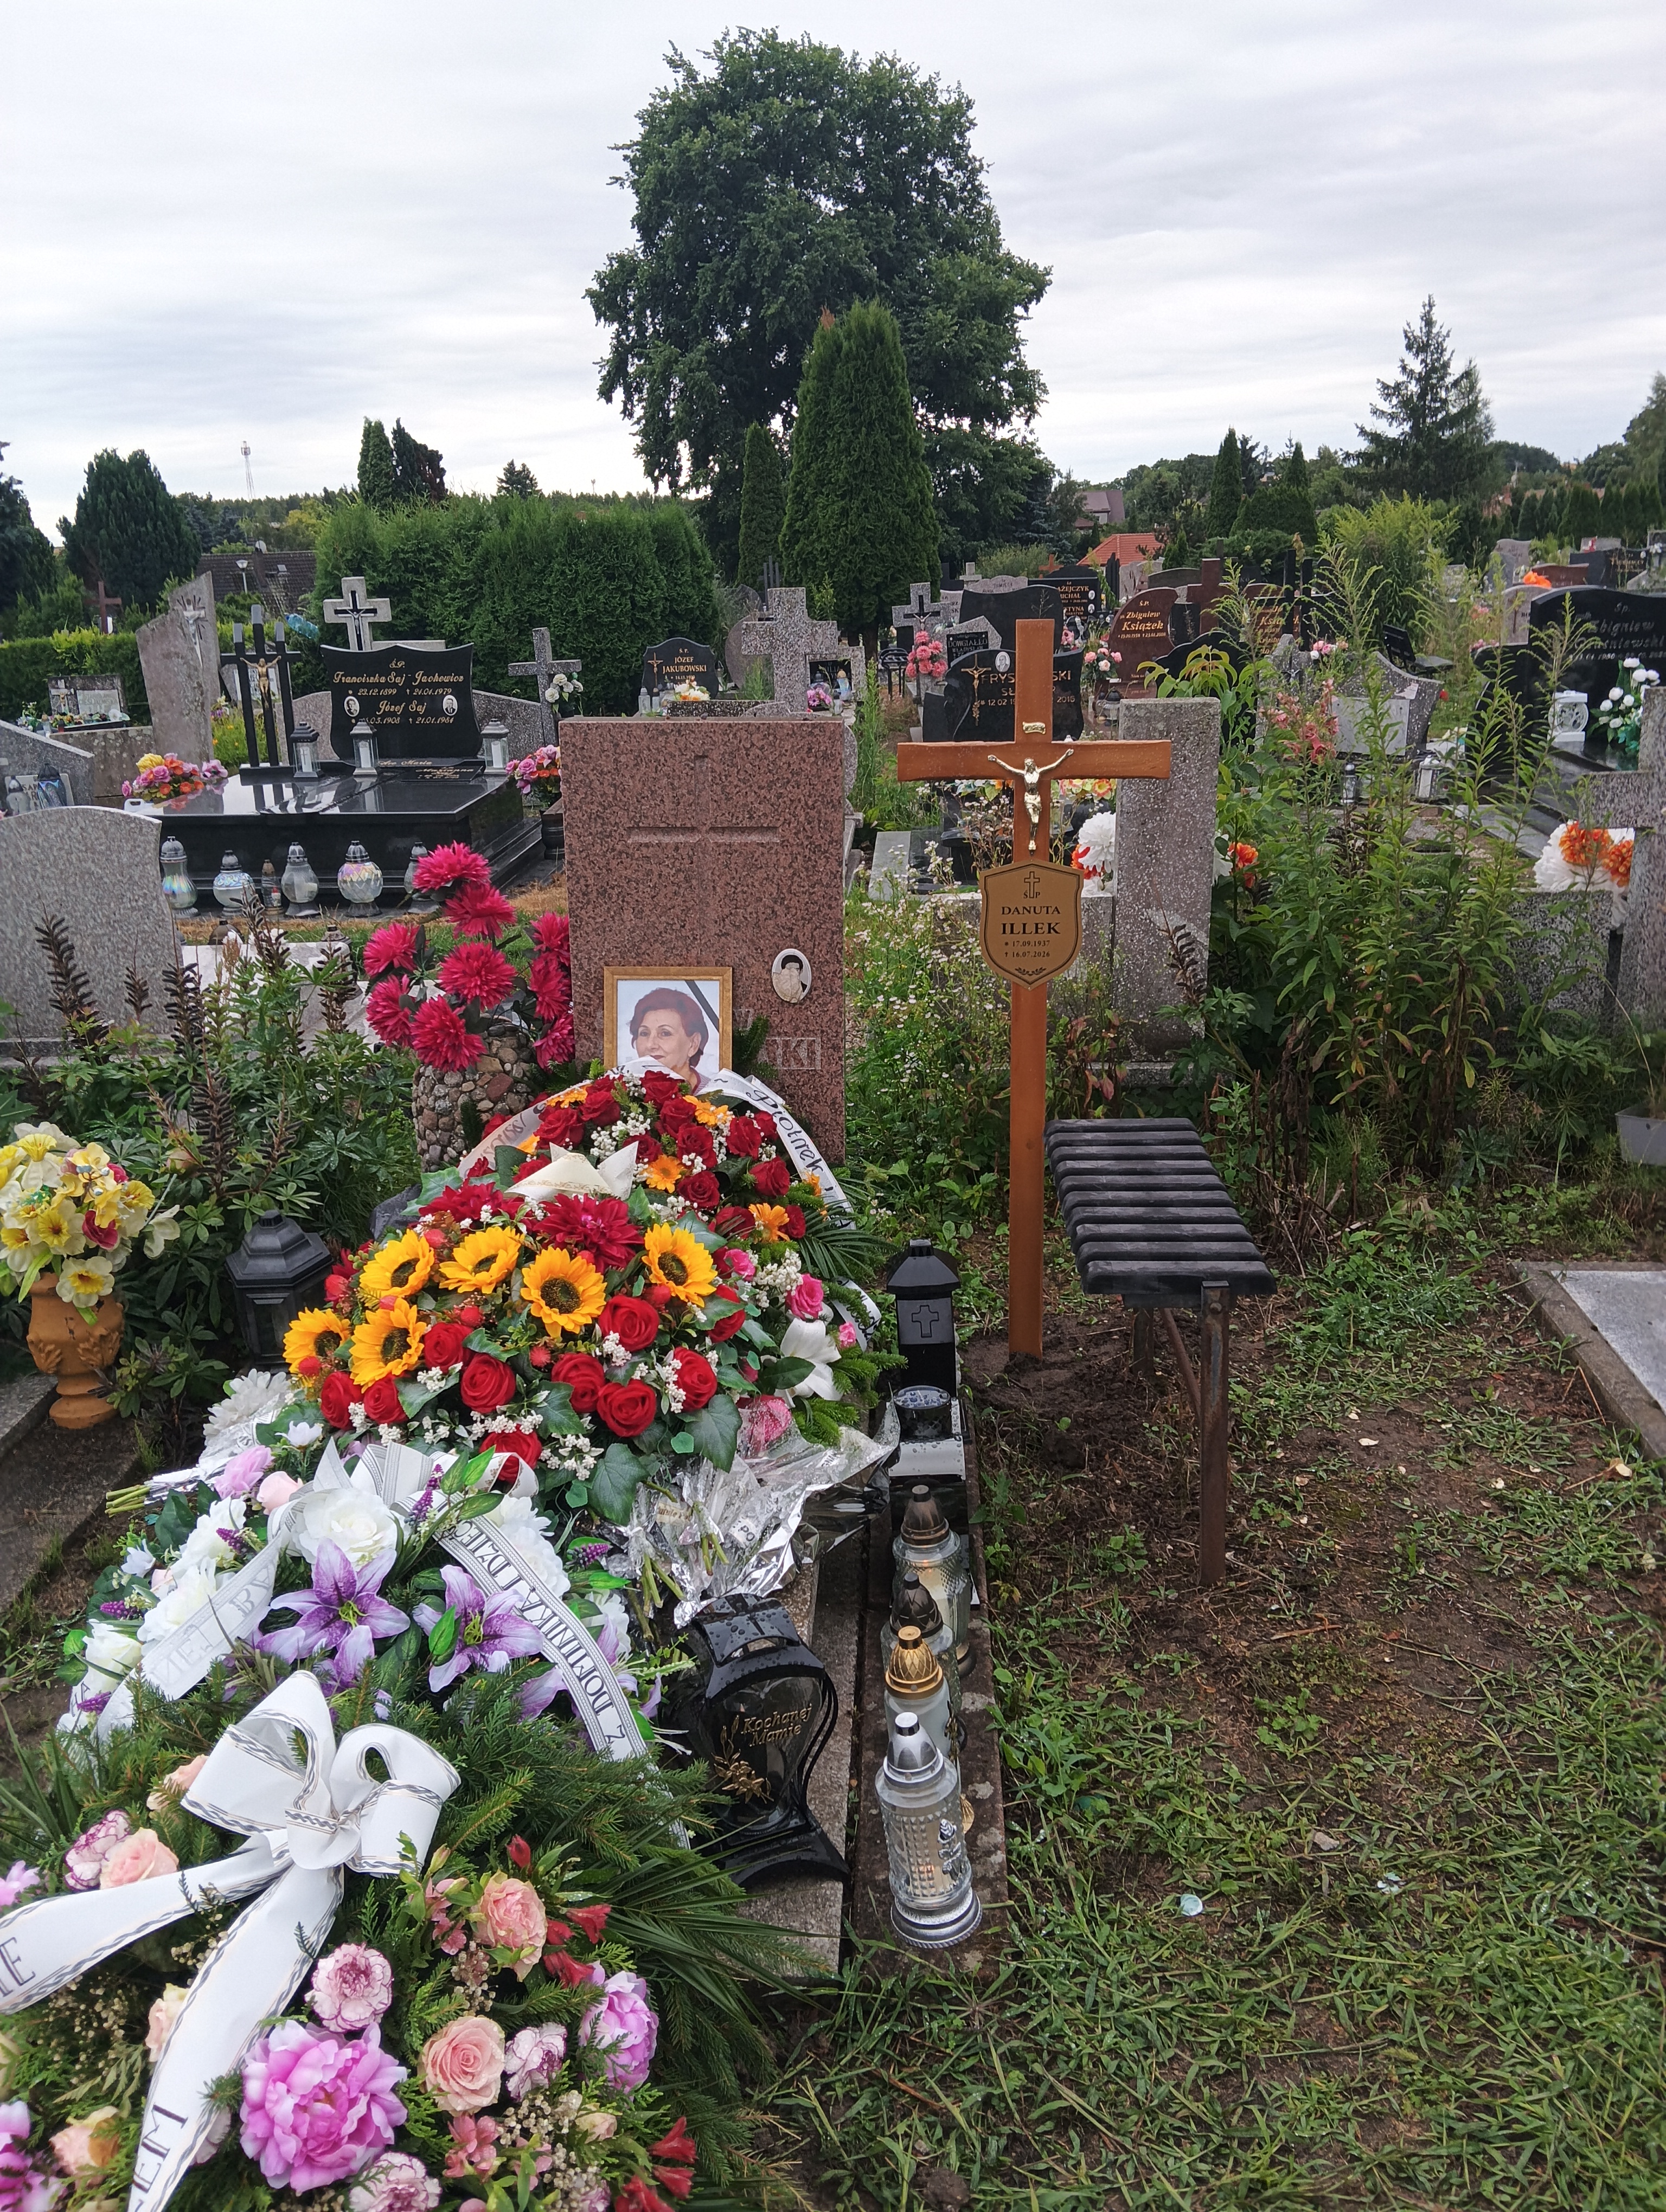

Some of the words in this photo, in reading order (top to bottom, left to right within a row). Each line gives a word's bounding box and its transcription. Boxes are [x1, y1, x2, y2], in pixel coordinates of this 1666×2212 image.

[1126, 611, 1161, 620] Zbigniew
[1122, 620, 1164, 632] Książek
[948, 639, 988, 647] DOWGIAŁŁO
[662, 664, 707, 673] JAKUBOWSKI
[333, 671, 387, 683] Franciszka
[387, 671, 406, 686] Saj
[376, 700, 405, 715] Józef
[408, 700, 427, 715] Saj
[1001, 905, 1061, 915] DANUTA
[1001, 922, 1061, 935] ILLEK
[500, 1573, 525, 1591] I
[741, 1703, 812, 1734] Kochanej
[603, 1724, 626, 1745] Z
[748, 1724, 802, 1747] Mamie
